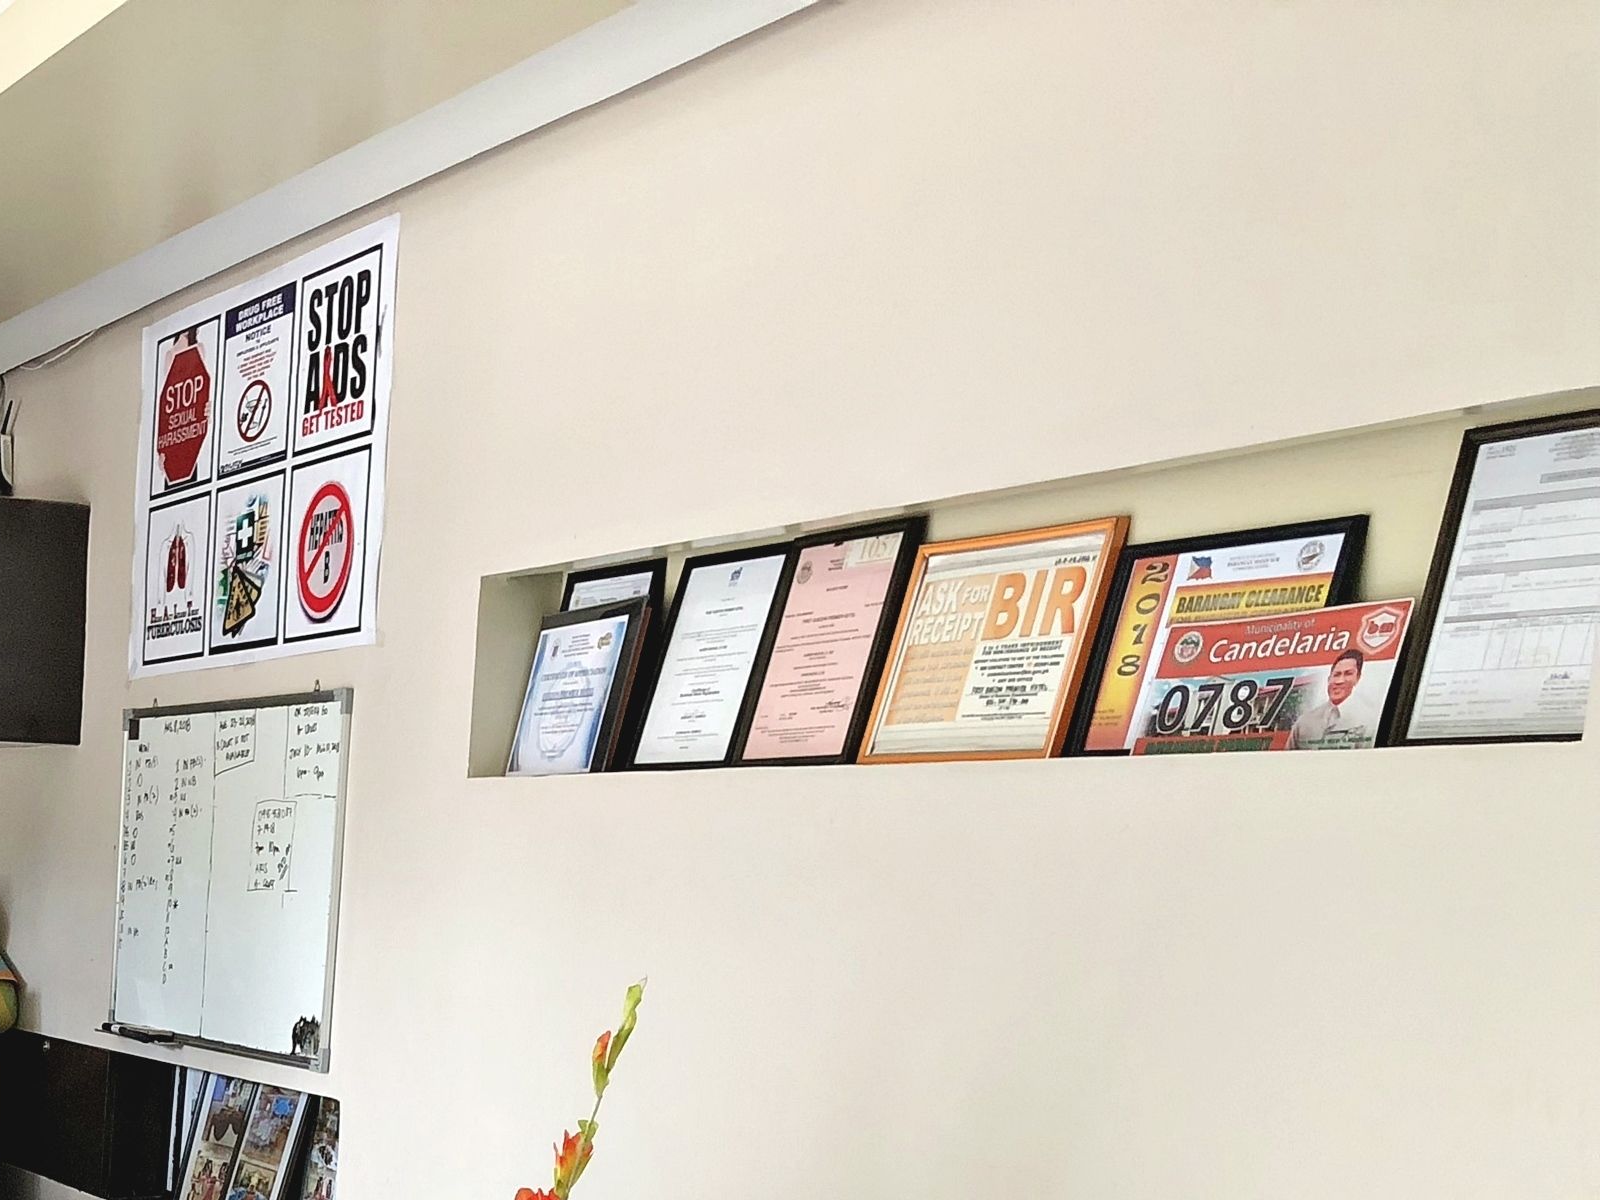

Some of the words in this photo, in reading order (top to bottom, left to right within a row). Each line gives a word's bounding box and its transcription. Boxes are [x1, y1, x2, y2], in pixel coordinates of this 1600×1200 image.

[236, 304, 284, 332] WORKPLACE
[238, 303, 260, 320] DRUG
[262, 294, 283, 311] FREE
[308, 269, 371, 351] STOP
[245, 325, 271, 342] NOTICE
[166, 376, 203, 413] STOP
[159, 420, 208, 448] HARASSMENT
[168, 409, 197, 430] SEXUAL
[302, 414, 320, 437] GET
[324, 400, 364, 430] TESTED
[323, 551, 330, 583] B
[916, 581, 965, 618] ASK
[962, 585, 991, 605] FOR
[981, 566, 1087, 641] BIR
[1176, 590, 1245, 613] BARANGAY
[1245, 584, 1324, 608] CLEARANCE
[147, 616, 202, 640] TUBERCULOSIS
[909, 612, 984, 646] RECEIPT
[1209, 627, 1350, 663] Candelaria
[1157, 677, 1294, 734] 0787
